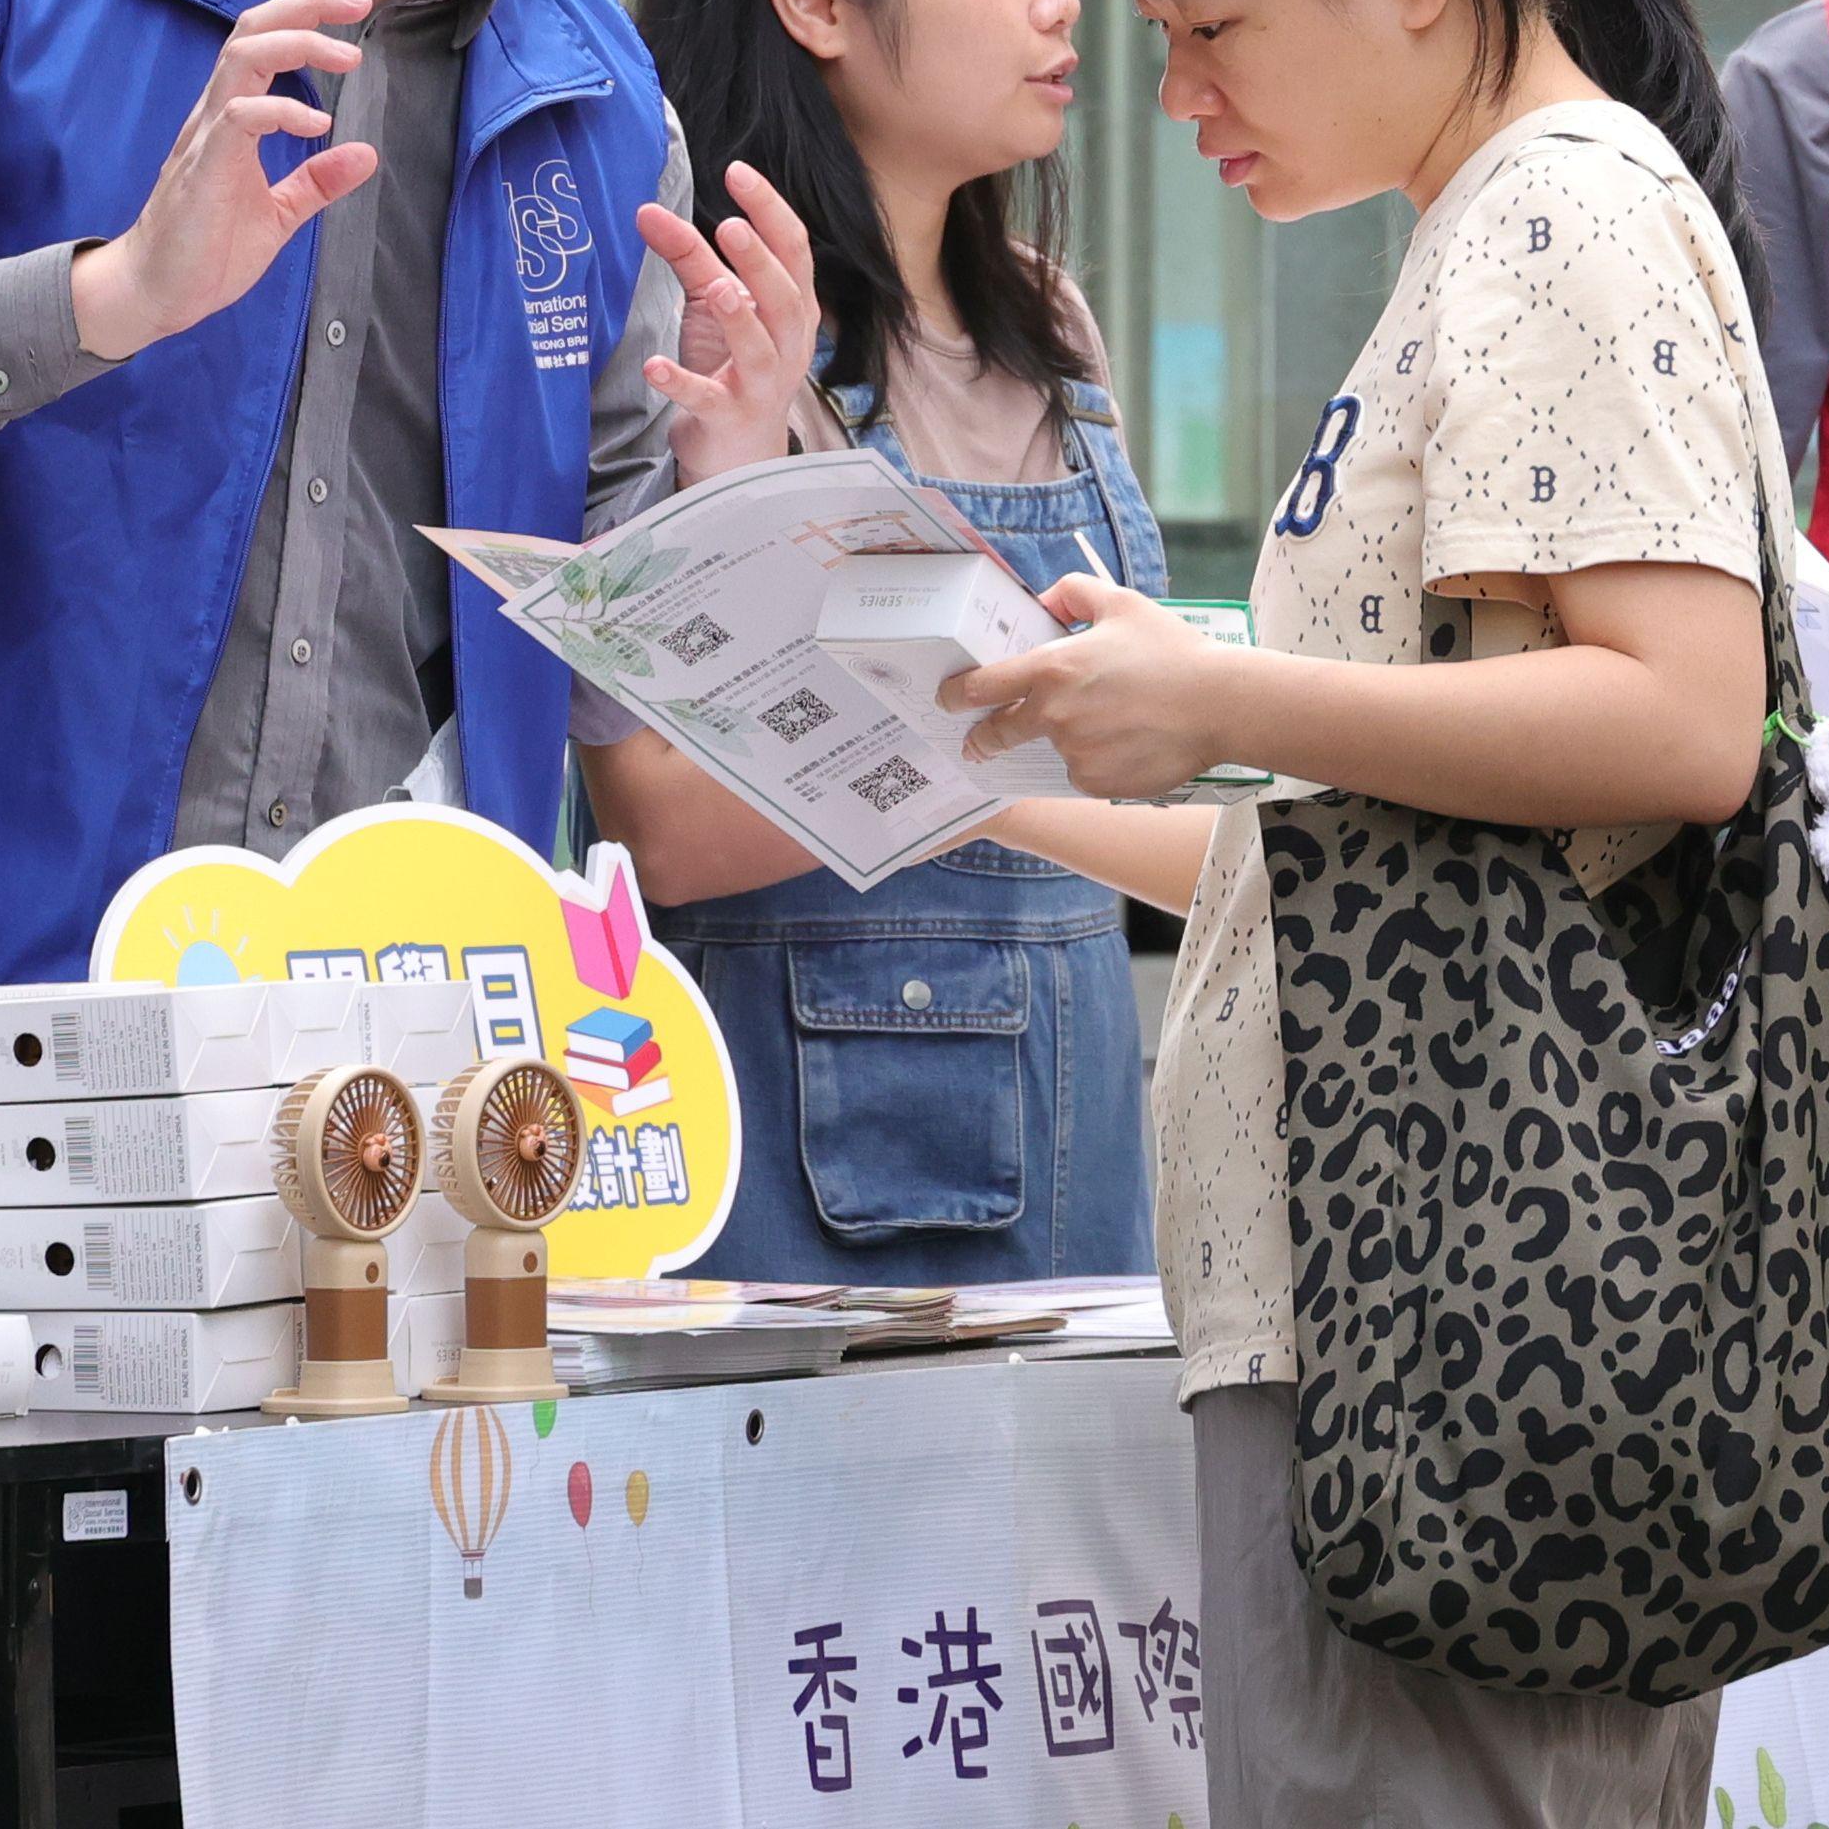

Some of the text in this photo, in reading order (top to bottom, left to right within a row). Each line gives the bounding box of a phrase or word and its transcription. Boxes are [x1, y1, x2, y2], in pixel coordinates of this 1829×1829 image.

[1274, 390, 1364, 542] B
[859, 594, 903, 608] SERIES
[788, 1596, 1205, 1792] 香港國際
